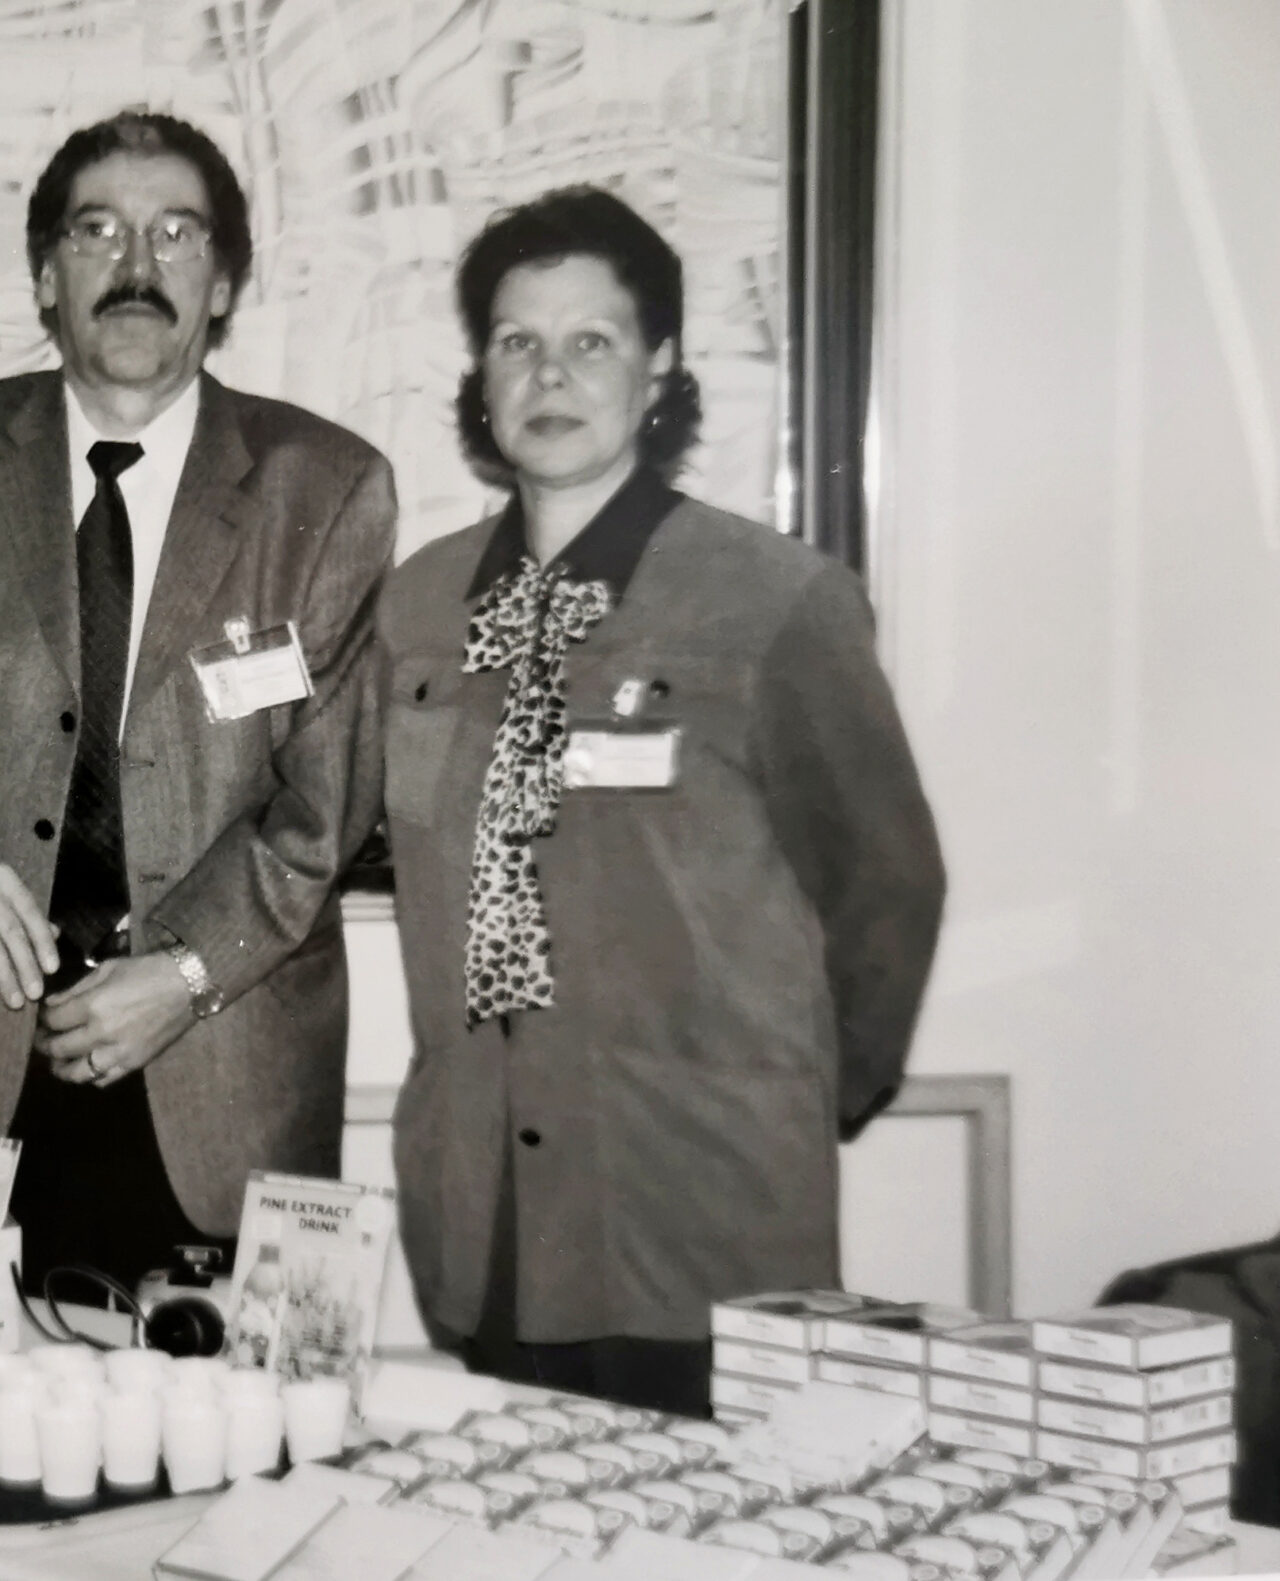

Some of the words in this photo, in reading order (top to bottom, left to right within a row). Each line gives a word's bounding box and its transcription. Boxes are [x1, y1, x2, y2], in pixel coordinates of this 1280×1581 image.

[260, 1196, 287, 1212] PINE
[291, 1200, 352, 1219] EXTRACT
[298, 1217, 340, 1235] DRINK
